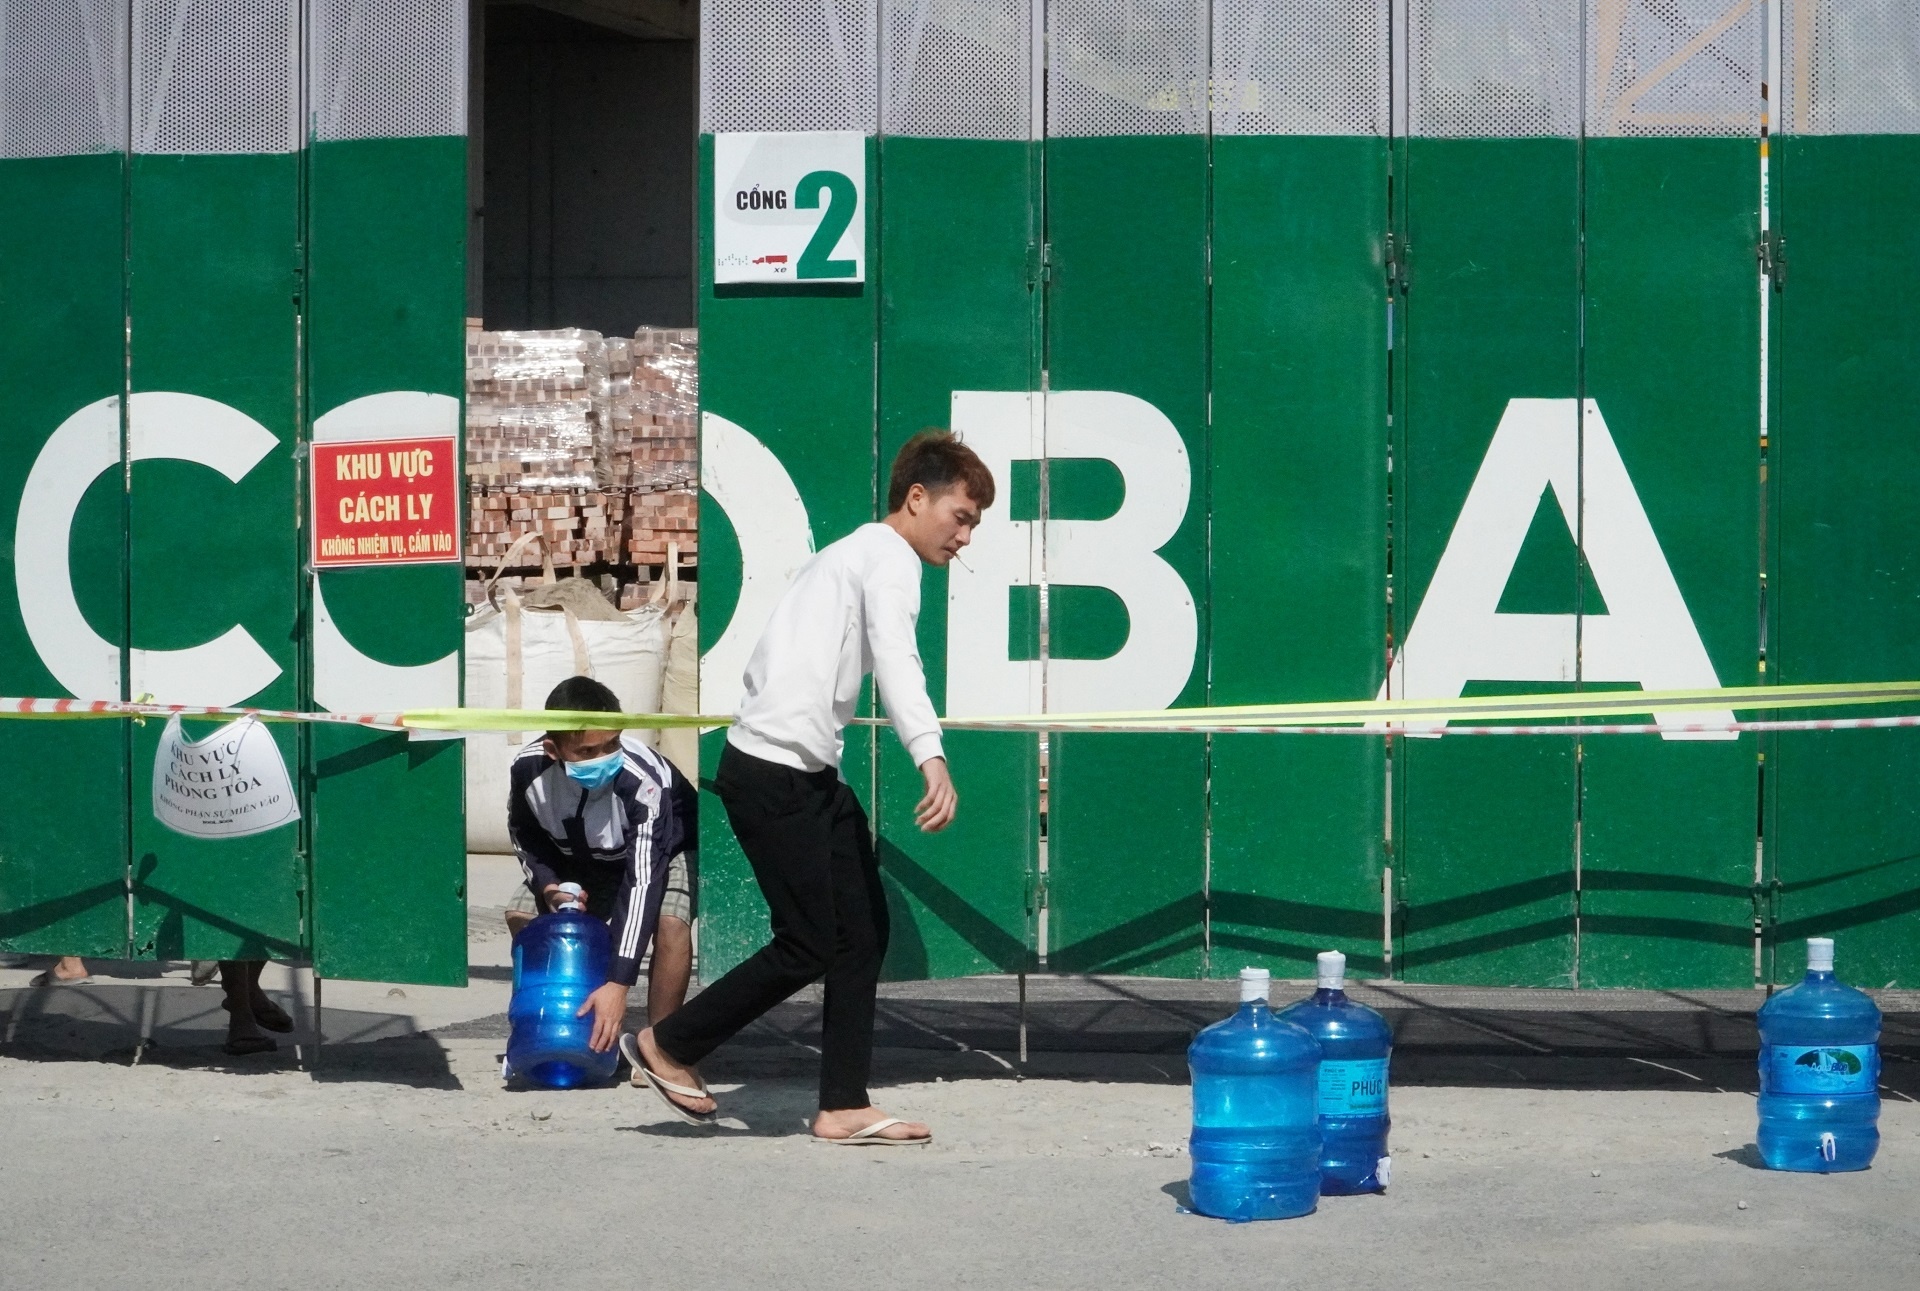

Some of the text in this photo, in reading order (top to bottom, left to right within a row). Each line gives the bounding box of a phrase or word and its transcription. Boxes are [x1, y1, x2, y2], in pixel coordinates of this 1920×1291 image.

[736, 170, 858, 279] CỔNG 2
[336, 448, 434, 483] KHU VỰC
[339, 491, 433, 523] CÁCH LY
[321, 529, 452, 558] KHÔNG NHIỆM VỤ, CẤM VÀO
[170, 740, 238, 765] KHU VỰC
[170, 760, 241, 783] CÁCH LY
[1351, 1076, 1383, 1096] PHÚC
